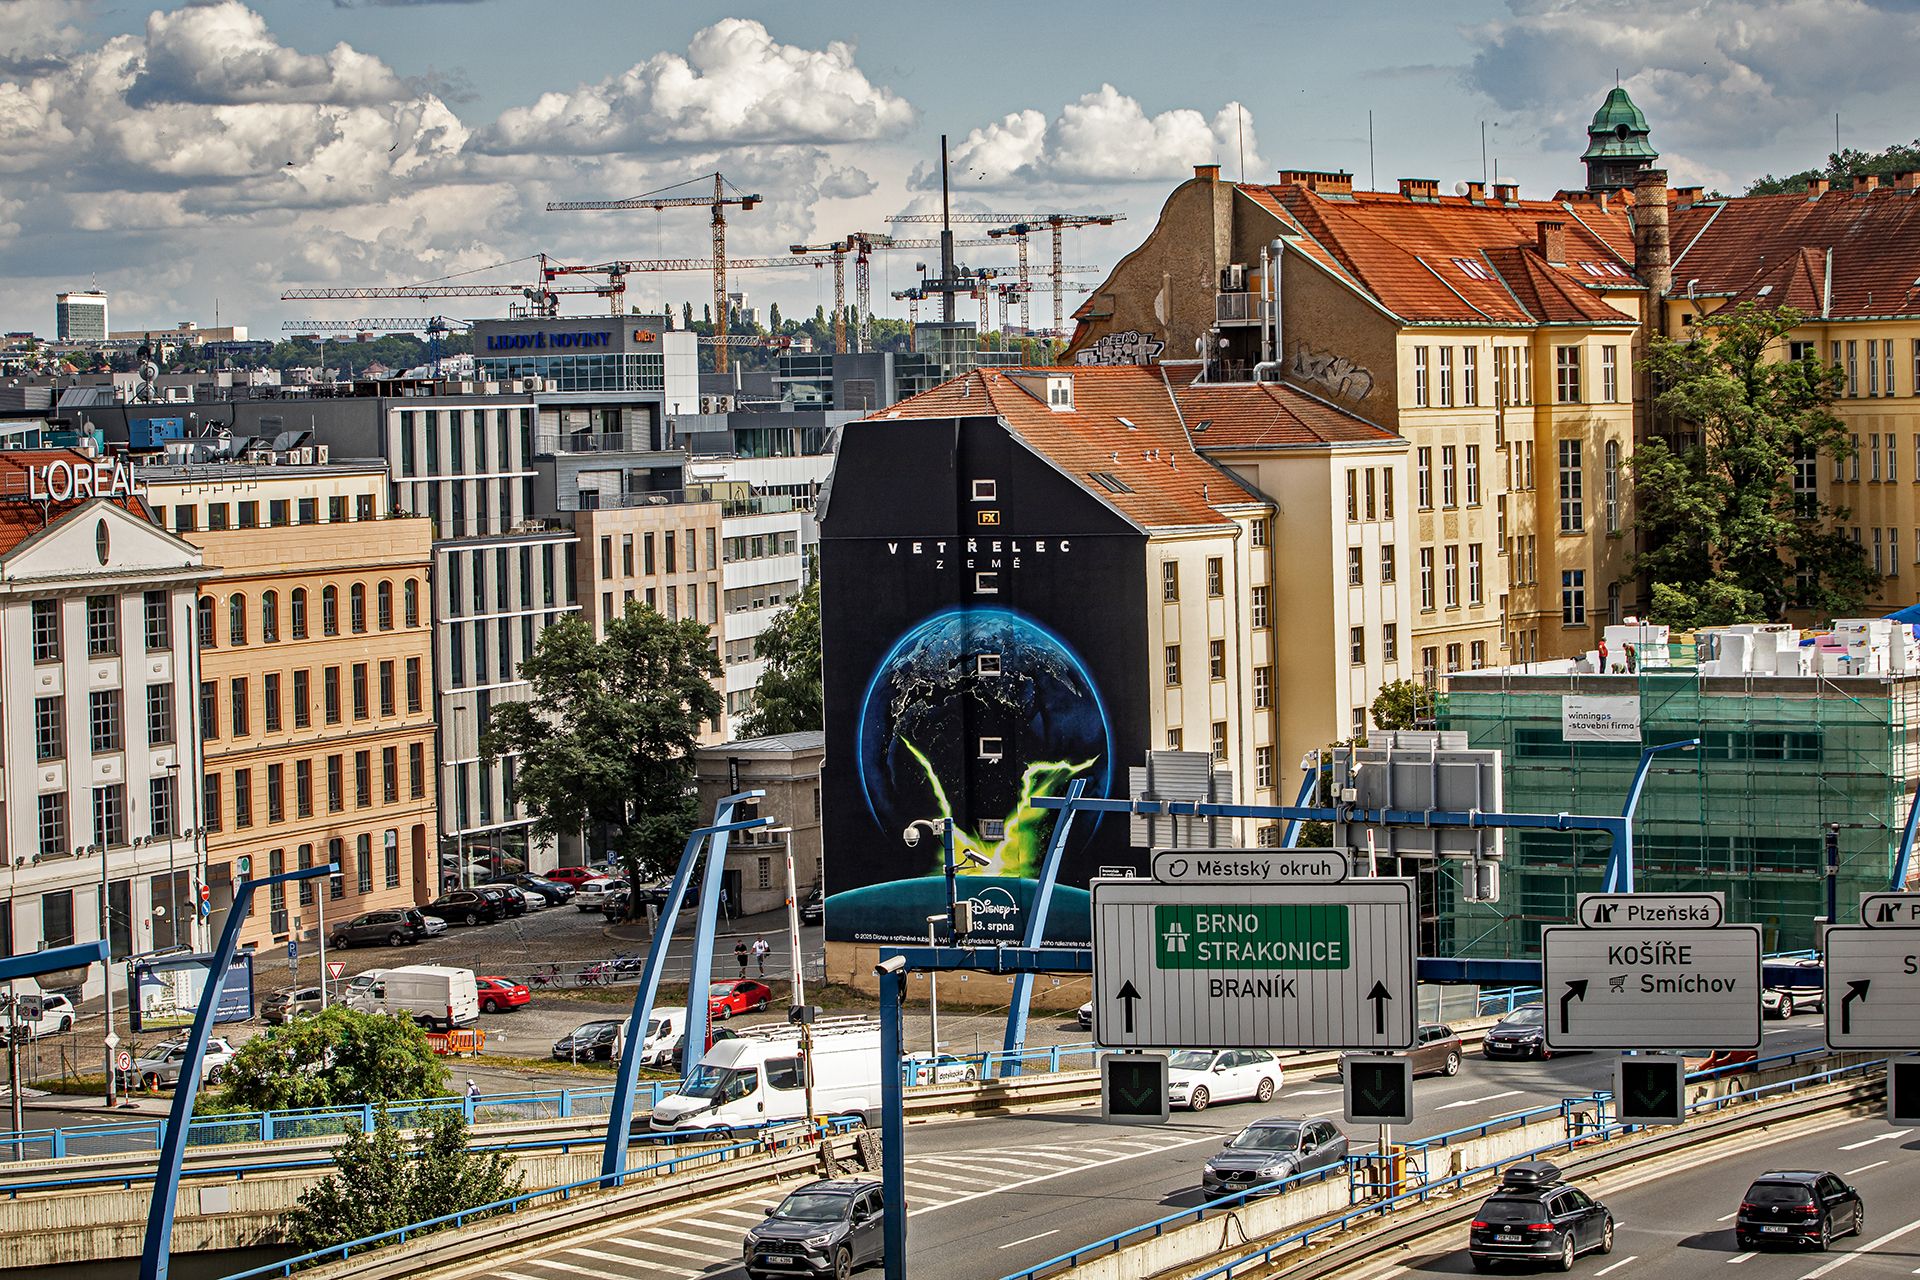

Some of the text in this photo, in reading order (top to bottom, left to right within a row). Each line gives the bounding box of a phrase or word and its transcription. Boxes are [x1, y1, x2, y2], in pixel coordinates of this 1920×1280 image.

[487, 331, 612, 350] LIDOVÉ NOVINY
[982, 513, 995, 523] FX
[888, 538, 1070, 554] VETŘELEC
[936, 557, 1021, 569] ZEMĚ
[1568, 712, 1612, 721] winningps
[1611, 722, 1634, 730] firma
[1197, 860, 1332, 879] Městský okruh
[1628, 904, 1710, 922] Plzeňská
[973, 921, 1015, 933] 13. srpna
[1196, 913, 1259, 933] BRNO
[1198, 941, 1341, 961] STRAKONICE
[1608, 941, 1692, 965] KOŠÍŘE
[1903, 955, 1919, 975] S
[1210, 975, 1296, 998] BRANÍK
[1640, 974, 1736, 993] Smíchov
